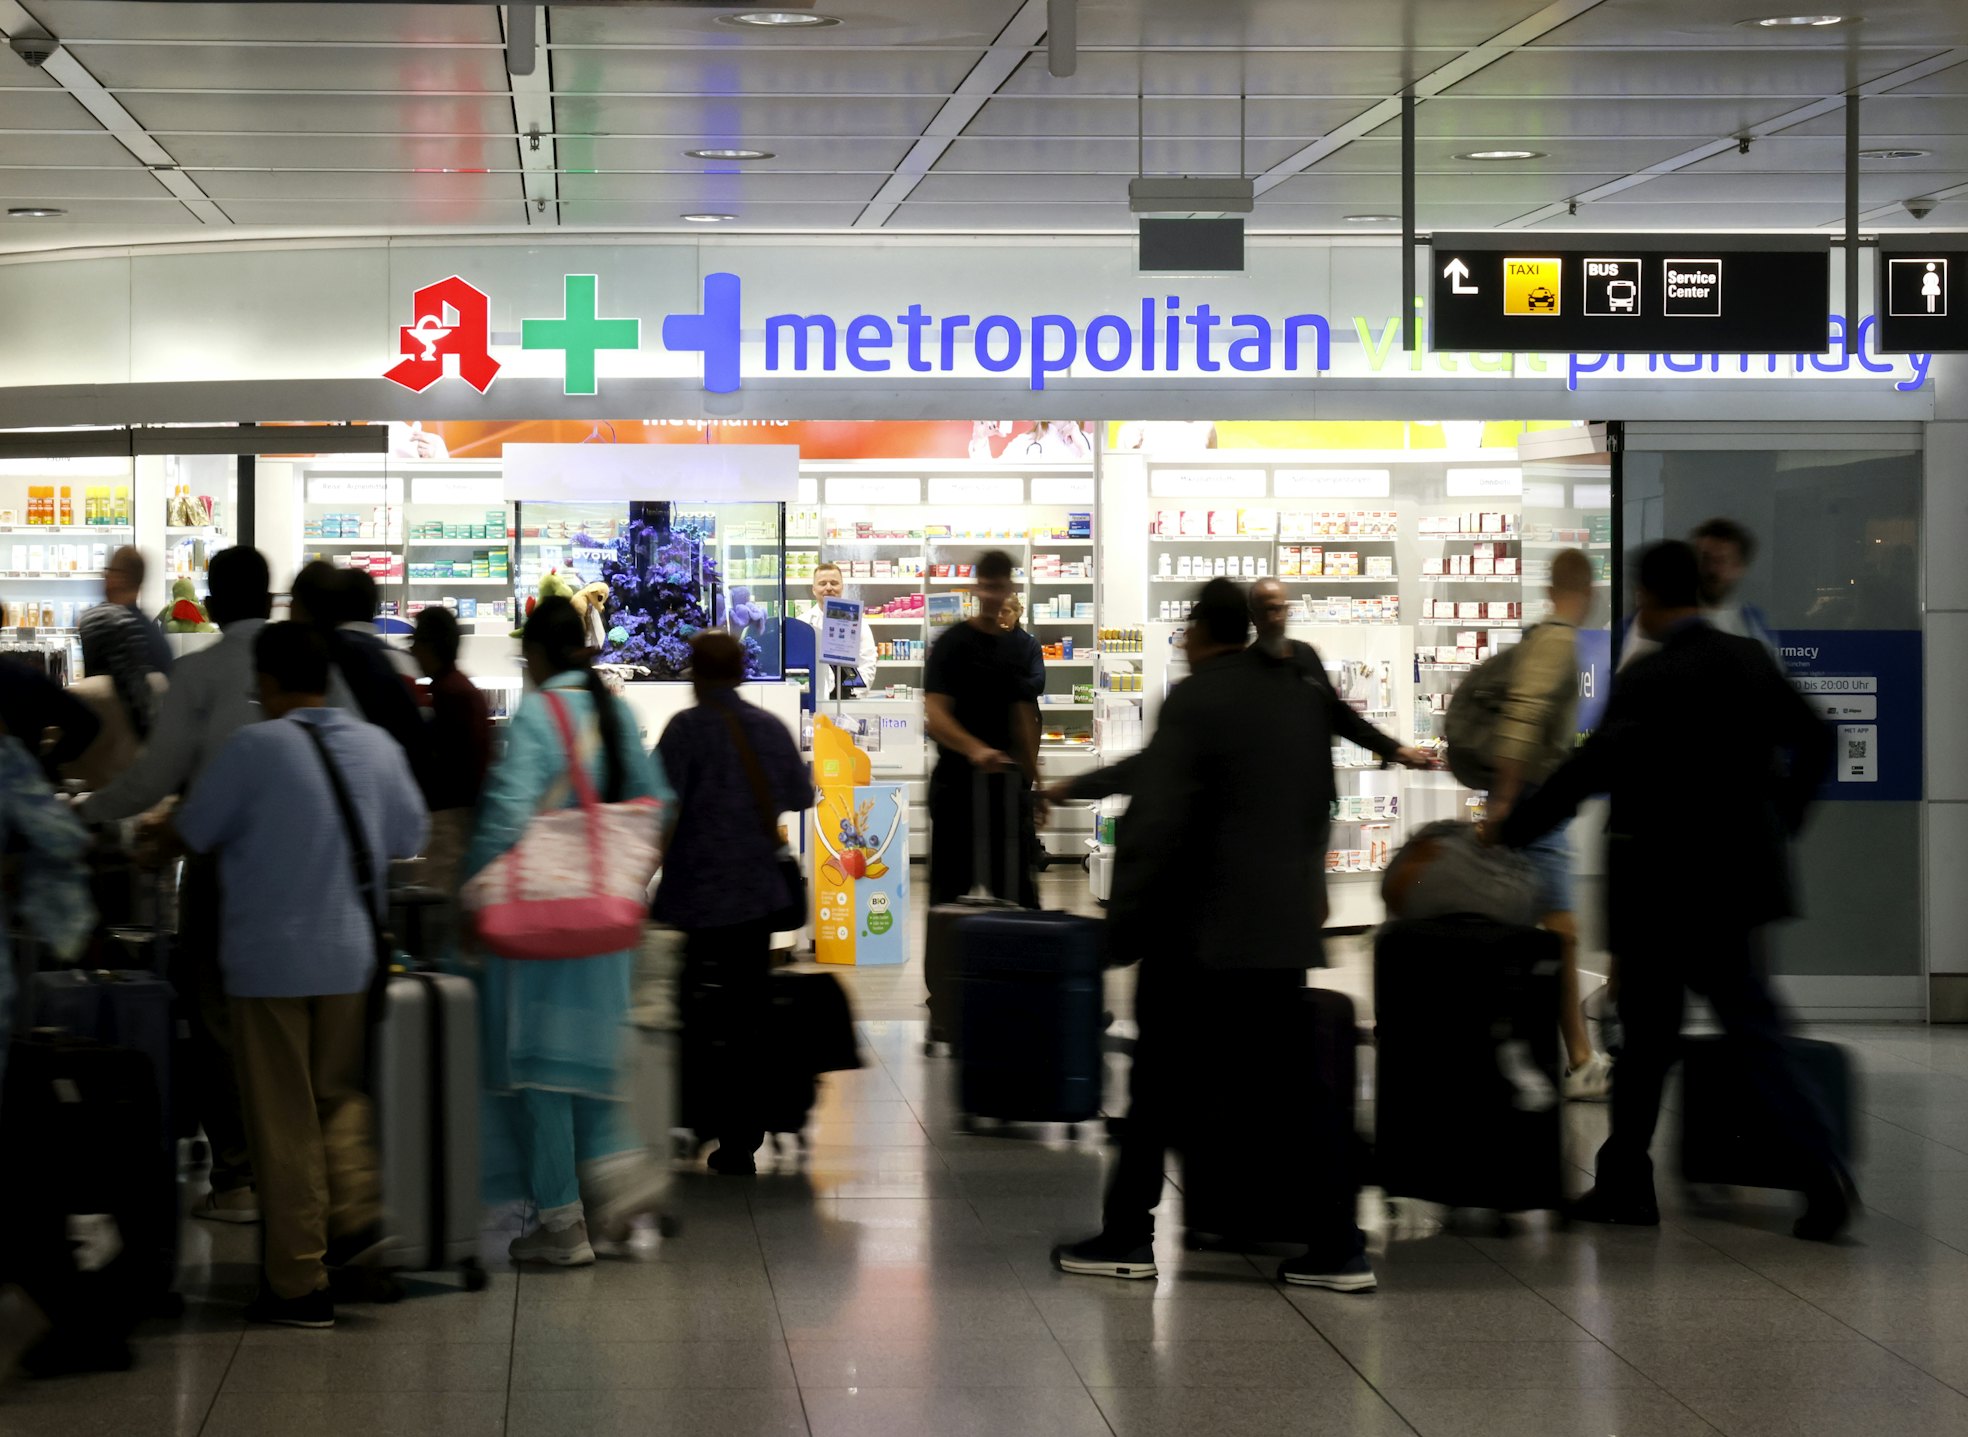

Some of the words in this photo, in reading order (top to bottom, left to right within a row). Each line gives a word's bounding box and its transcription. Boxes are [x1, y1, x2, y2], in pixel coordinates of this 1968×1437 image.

[1509, 264, 1540, 276] TAXI
[1588, 263, 1619, 277] BUS
[1667, 270, 1717, 285] Service
[1667, 284, 1710, 298] Center
[764, 295, 1330, 391] metropolitan
[1804, 680, 1818, 690] bis
[1820, 680, 1849, 690] 20:00
[1852, 680, 1870, 690] Uhr
